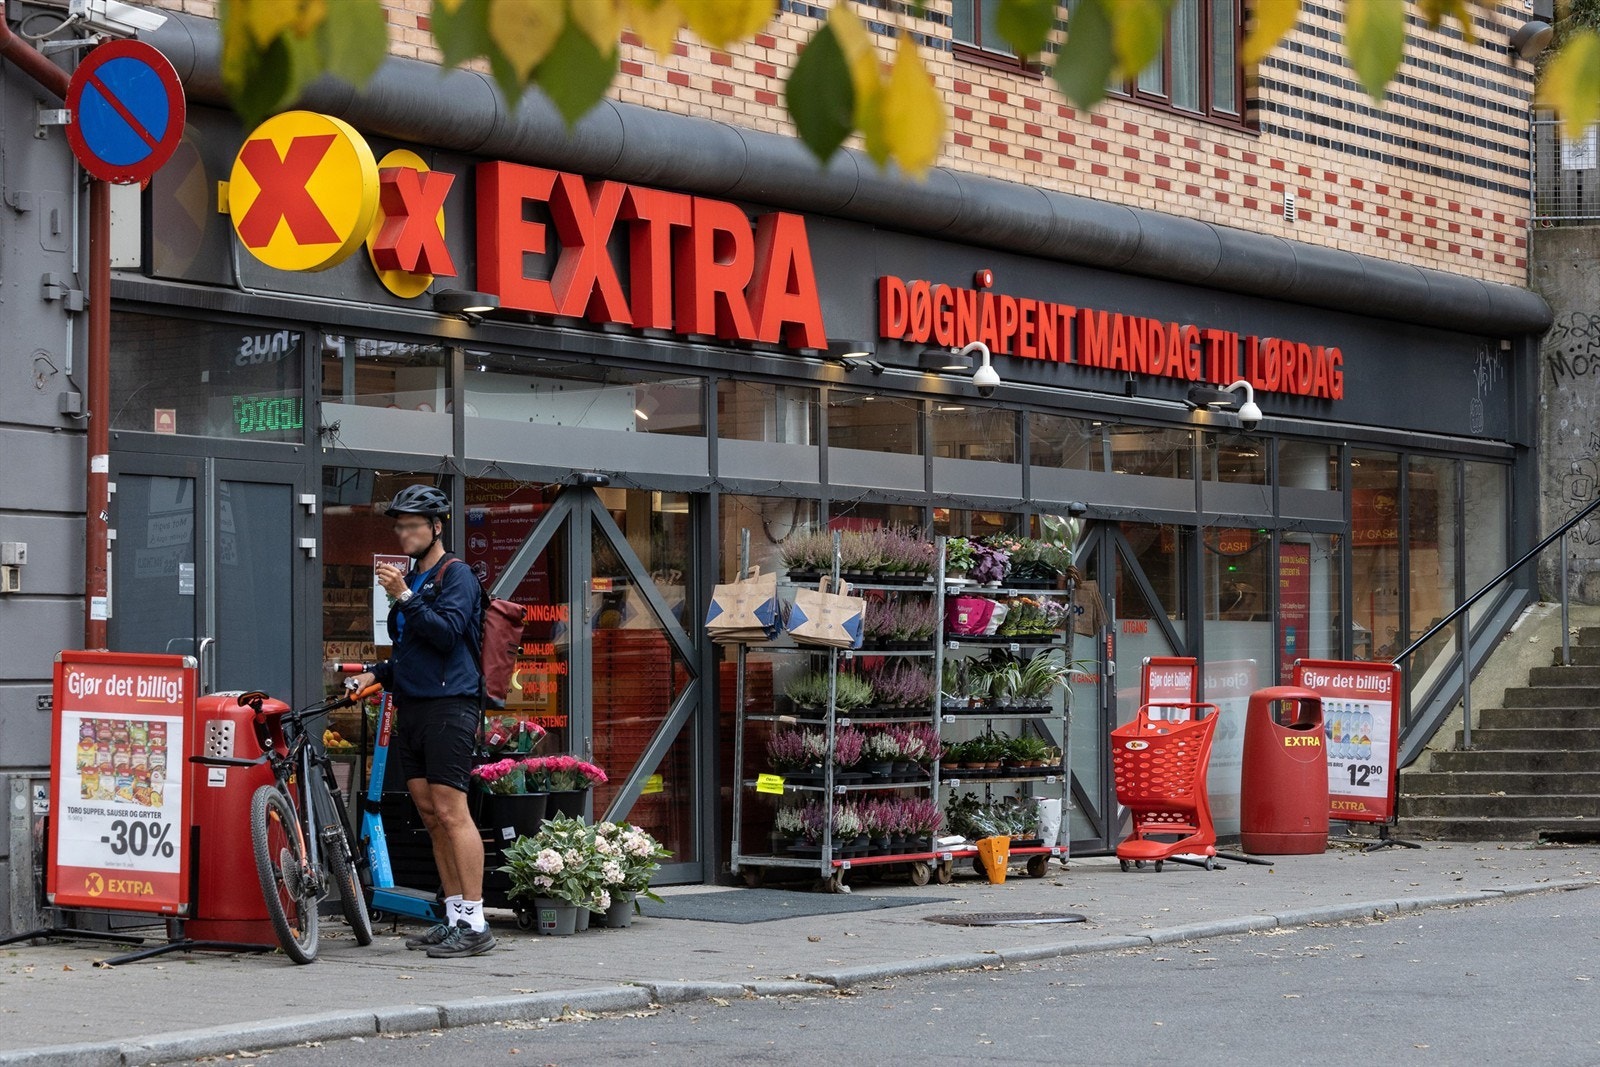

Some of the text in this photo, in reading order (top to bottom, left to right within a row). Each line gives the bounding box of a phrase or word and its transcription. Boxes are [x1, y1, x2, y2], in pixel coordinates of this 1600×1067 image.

[476, 160, 828, 350] EXTRA
[879, 268, 1344, 400] DØGNÅPENT MANDAG TIL LØRDAG
[1219, 543, 1248, 552] CASH
[1122, 621, 1148, 634] UTGANG
[68, 672, 183, 704] Gjør det billig!
[1150, 671, 1192, 691] Gjør det billig!
[1303, 671, 1391, 694] Gjør det billig!
[542, 715, 568, 728] STENGT
[1284, 736, 1321, 747] EXTRA
[1331, 800, 1366, 810] EXTRA
[83, 808, 105, 816] SUPPER,
[139, 811, 162, 819] GRYTER
[101, 820, 174, 858] -30%
[108, 879, 154, 895] EXTRA
